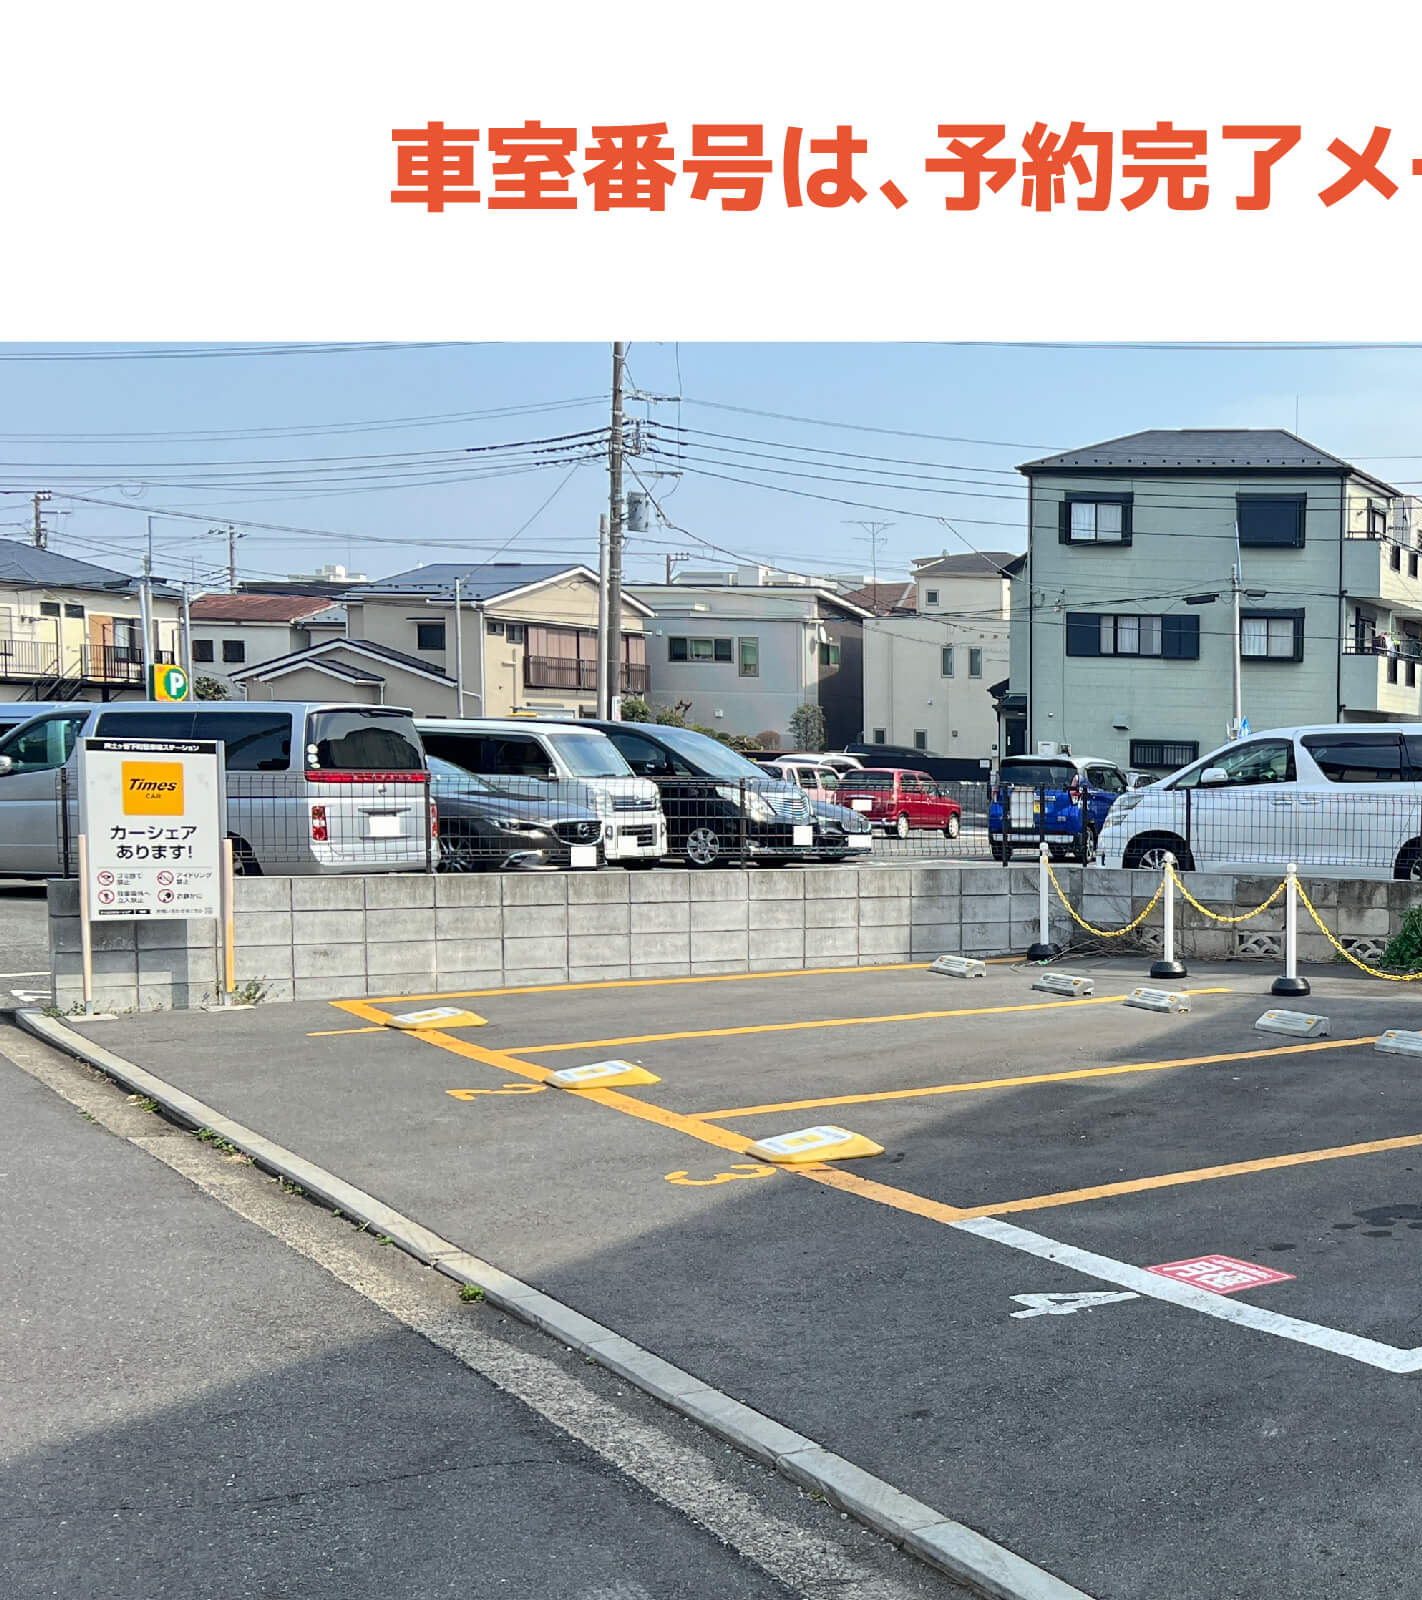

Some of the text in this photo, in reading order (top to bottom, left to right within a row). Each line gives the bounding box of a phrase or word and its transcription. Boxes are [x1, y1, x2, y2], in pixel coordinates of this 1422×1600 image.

[170, 672, 185, 696] P
[129, 778, 177, 791] Times
[110, 825, 197, 840] カーシェア
[446, 1083, 547, 1101] 2
[664, 1164, 777, 1186] 3
[1008, 1291, 1141, 1319] 4
